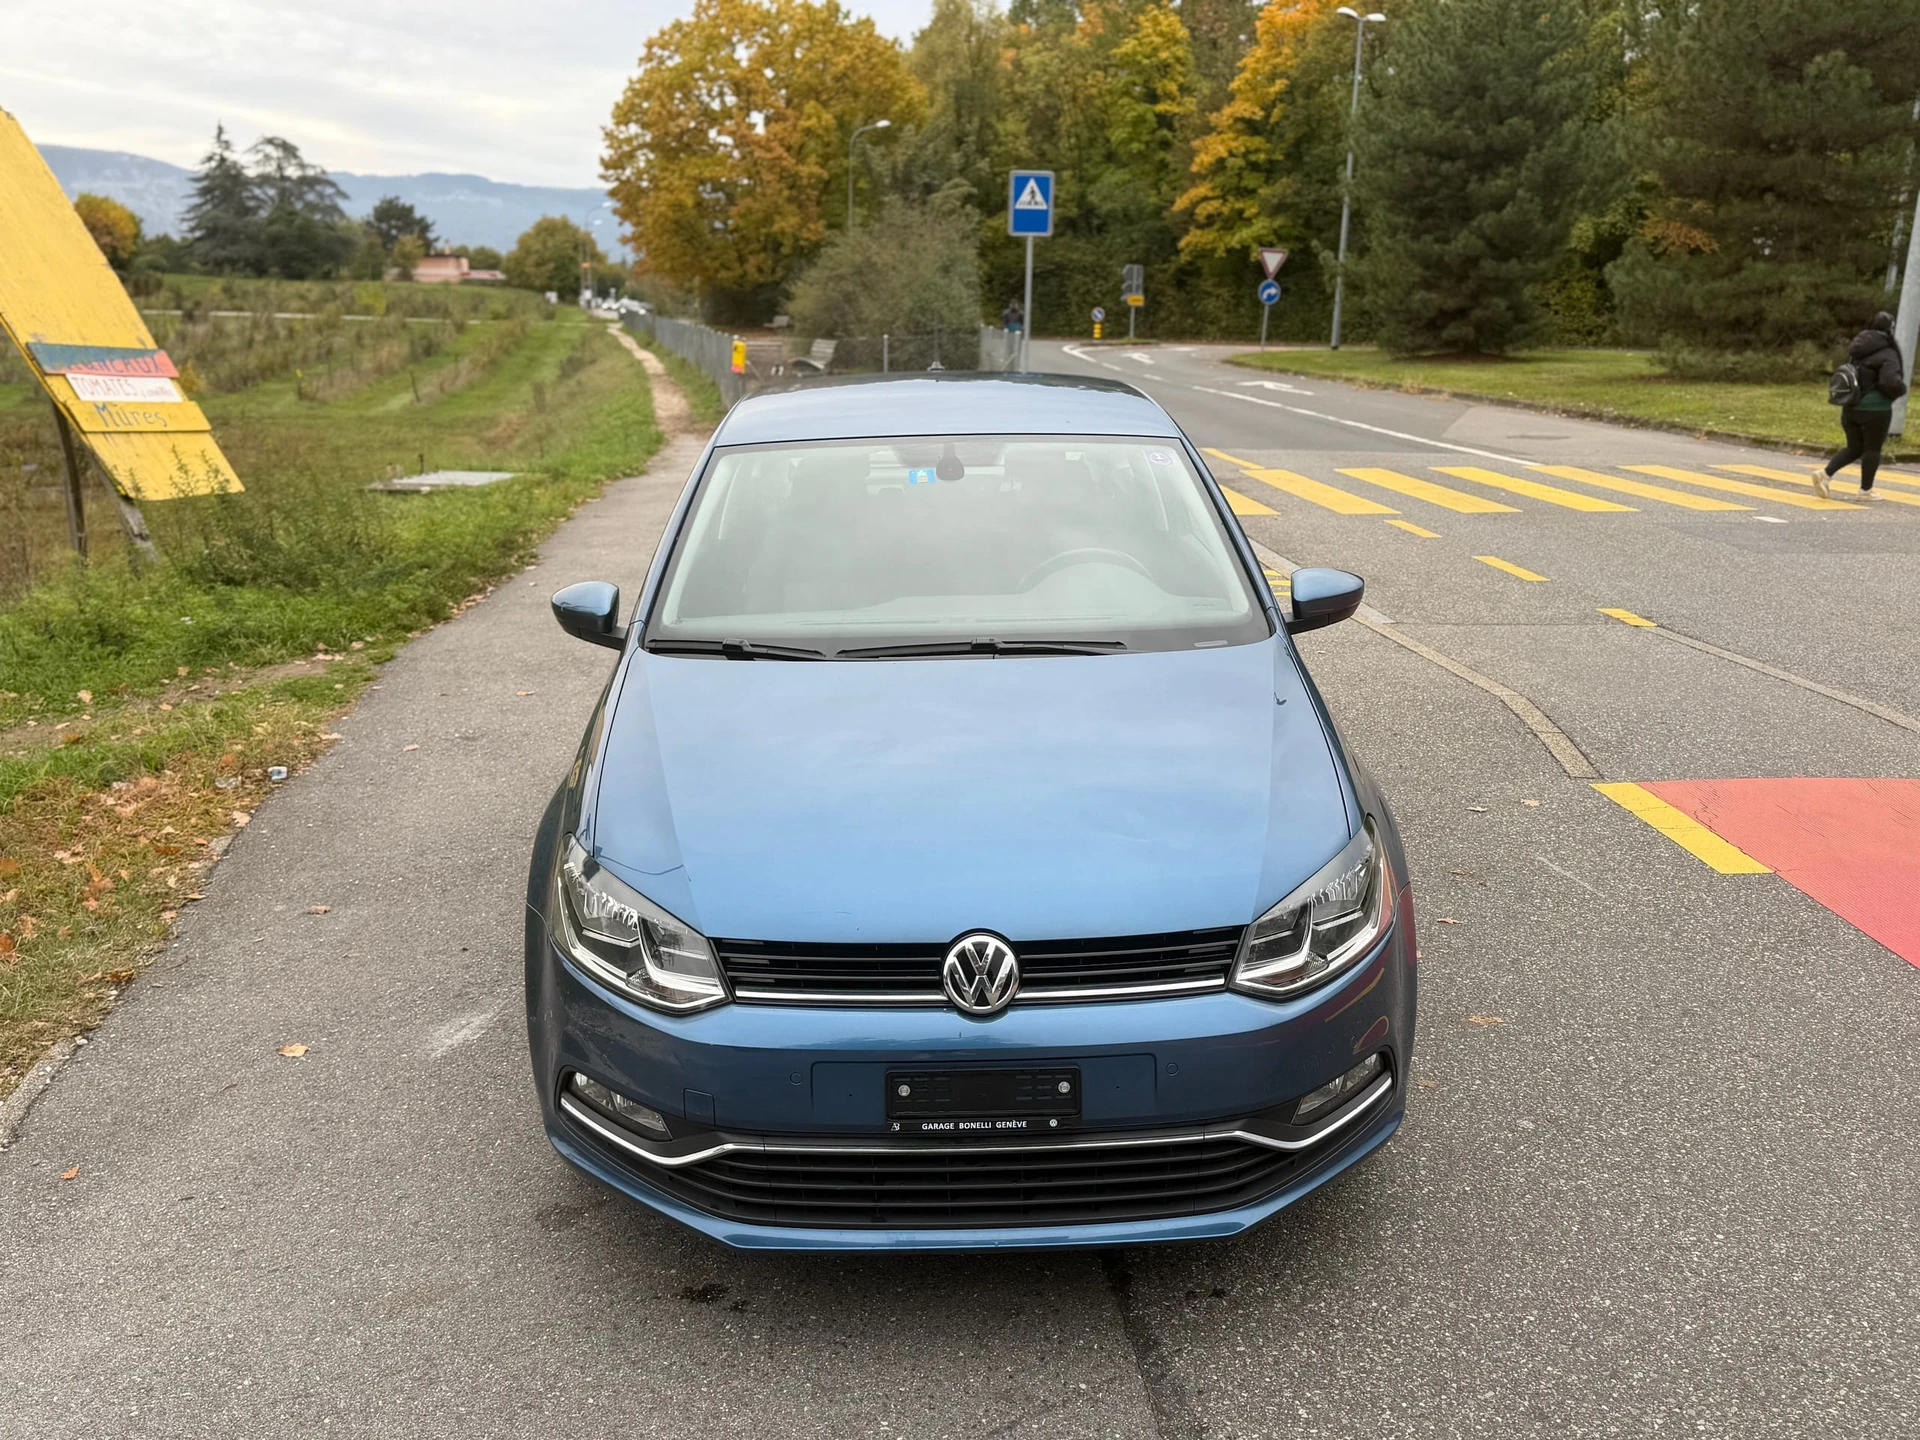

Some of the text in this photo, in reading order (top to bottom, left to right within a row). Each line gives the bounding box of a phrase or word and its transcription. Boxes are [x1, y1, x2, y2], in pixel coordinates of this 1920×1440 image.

[71, 377, 137, 397] TOMATES
[943, 933, 1019, 1014] VW
[921, 1120, 1027, 1130] GARAGE BONELLI GENÈVE
